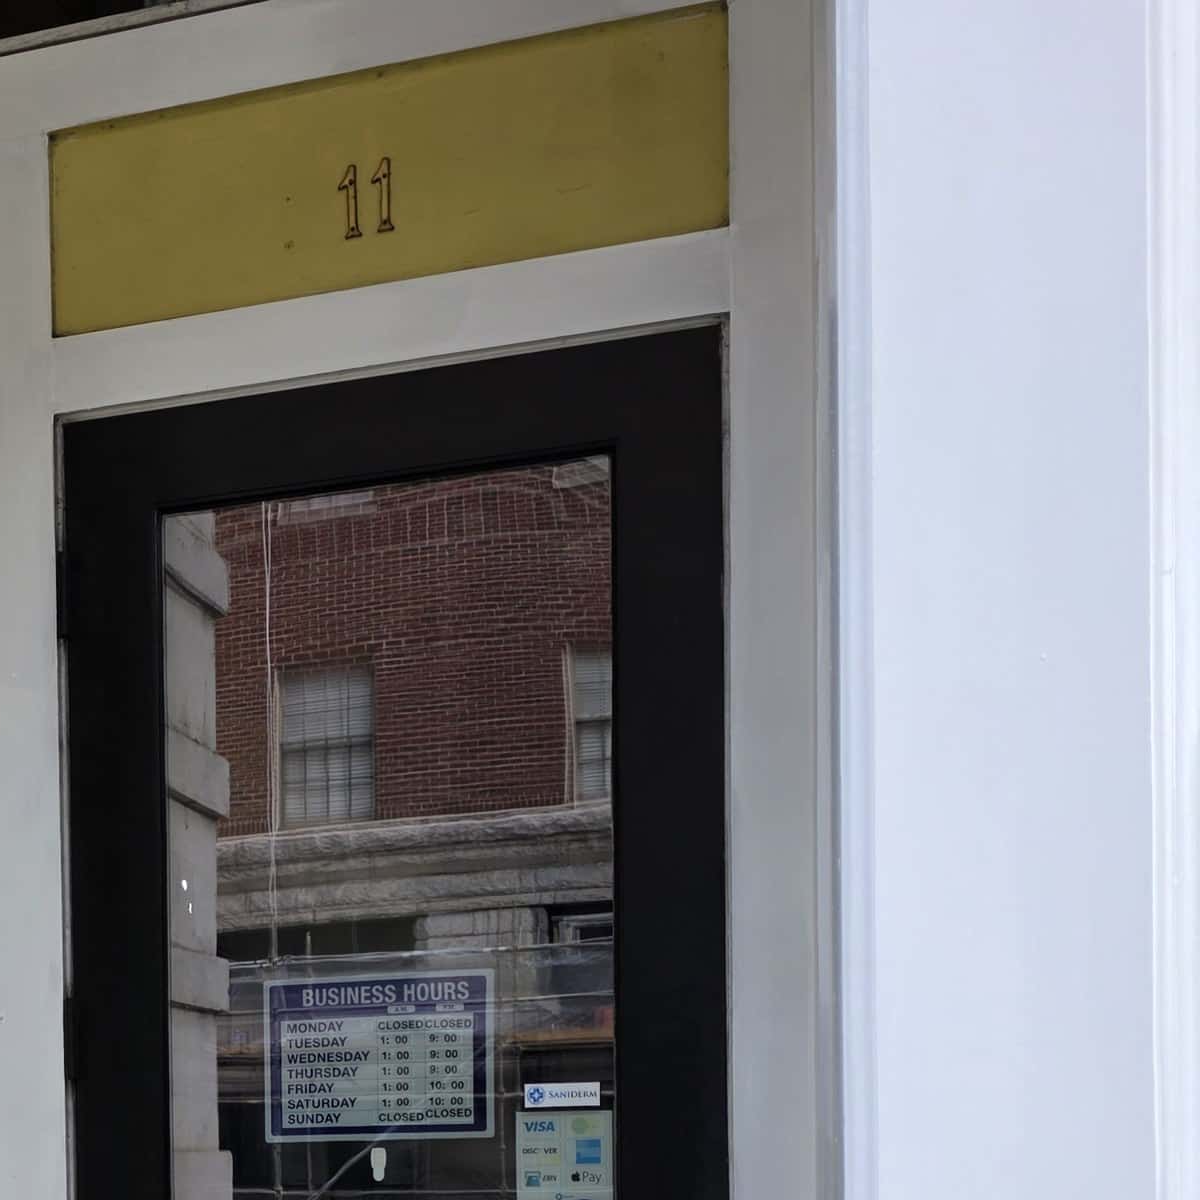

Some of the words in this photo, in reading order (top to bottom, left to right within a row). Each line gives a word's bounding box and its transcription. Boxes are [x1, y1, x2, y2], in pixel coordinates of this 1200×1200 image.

[337, 156, 395, 240] 11
[302, 985, 396, 1007] BUSINESS
[404, 981, 469, 1001] HOURS
[287, 1021, 344, 1033] MONDAY
[378, 1020, 423, 1030] CLOSED
[425, 1019, 471, 1028] CLOSED
[287, 1037, 348, 1048] TUESDAY
[287, 1051, 370, 1064] WEDNESDAY
[287, 1067, 359, 1079] THURSDAY
[287, 1083, 334, 1094] FRIDAY
[287, 1097, 357, 1109] SATURDAY
[287, 1113, 341, 1125] SUNDAY
[378, 1112, 424, 1122] CLOSED
[426, 1108, 472, 1118] CLOSED
[524, 1121, 555, 1132] VISA
[522, 1147, 558, 1155] DISCVER
[582, 1171, 602, 1184] Pay
